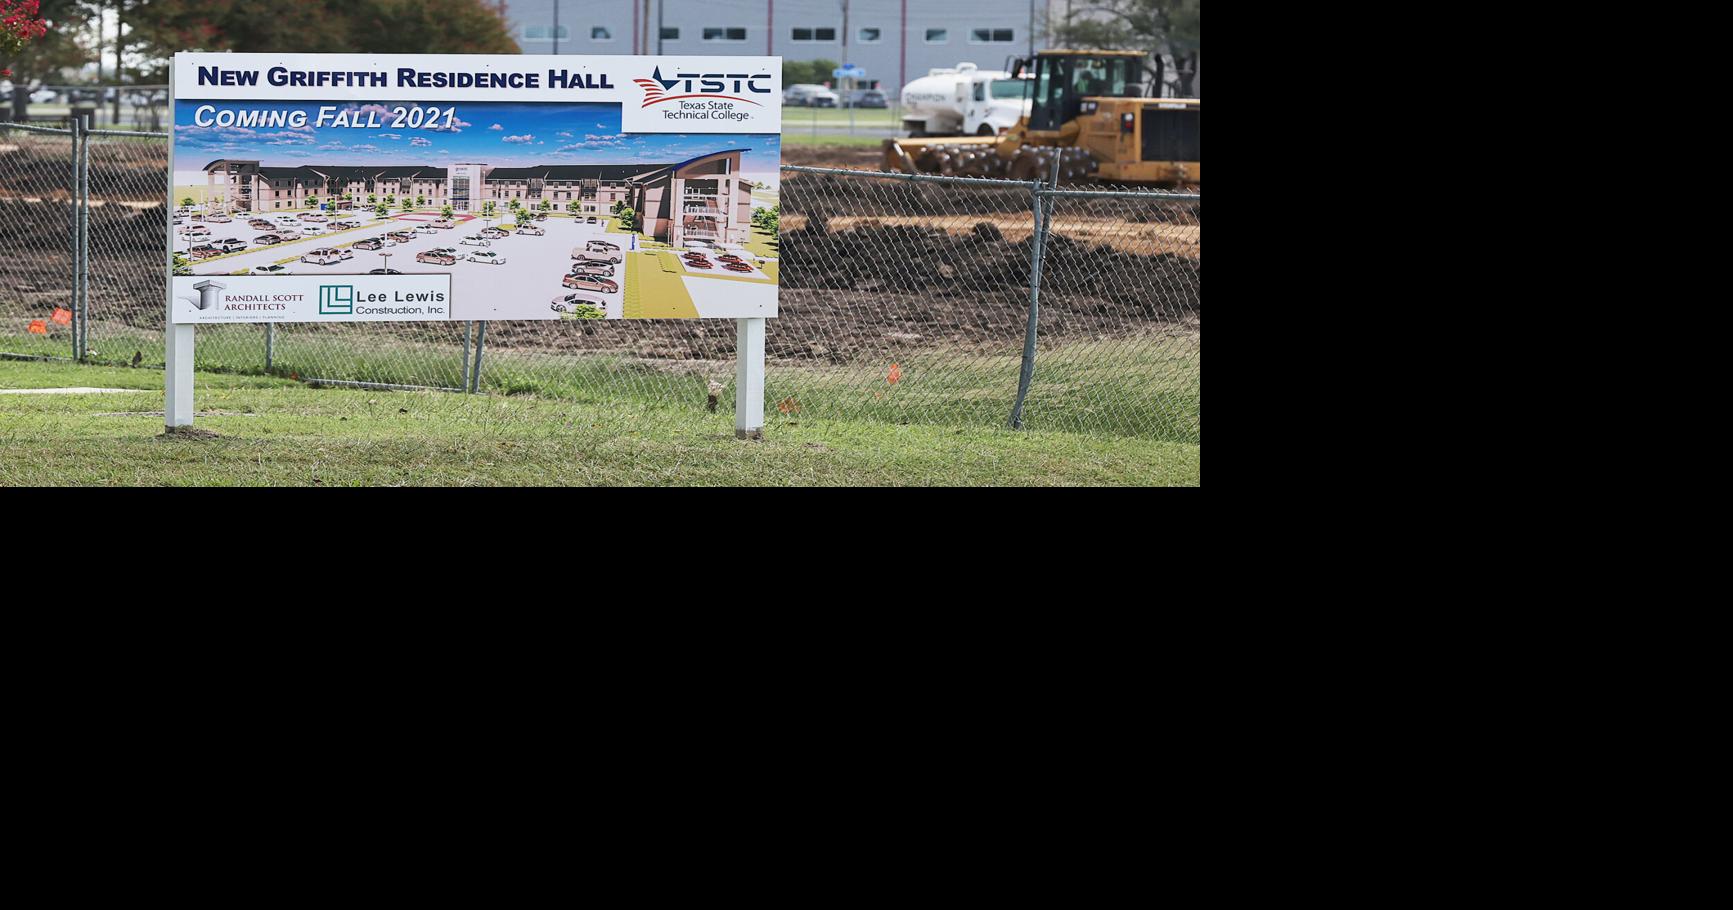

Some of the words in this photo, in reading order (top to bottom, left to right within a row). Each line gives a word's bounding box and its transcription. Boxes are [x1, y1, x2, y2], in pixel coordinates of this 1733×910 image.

[677, 73, 771, 93] TSTC
[679, 100, 706, 110] Texas
[708, 100, 734, 110] State
[391, 106, 456, 129] 2021
[662, 110, 709, 119] Technical
[711, 110, 749, 121] College
[356, 291, 387, 302] Lee
[394, 291, 445, 302] Lewis
[224, 303, 286, 311] ARCHITECTS
[355, 306, 424, 316] Construction,
[427, 307, 446, 315] Inc.
